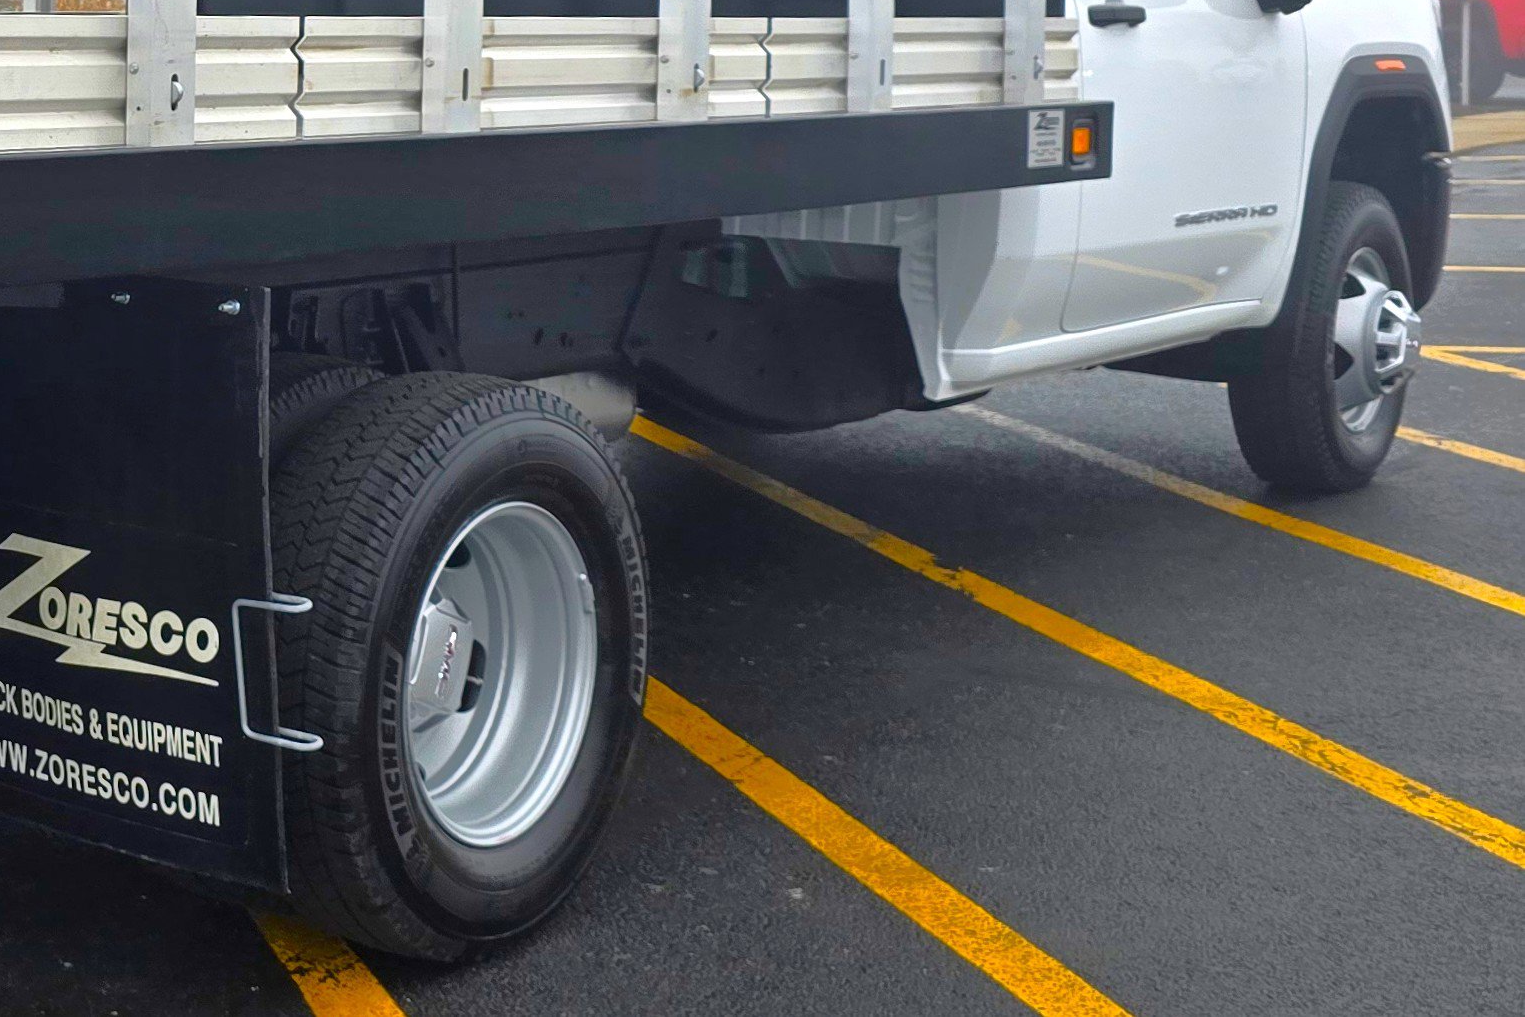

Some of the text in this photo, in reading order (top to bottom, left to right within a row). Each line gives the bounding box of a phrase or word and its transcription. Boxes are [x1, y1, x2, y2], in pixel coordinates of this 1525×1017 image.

[21, 688, 85, 736] BODIES
[88, 708, 104, 741] &
[106, 712, 223, 768] EQUIPMENT
[381, 655, 414, 837] MICHELIN
